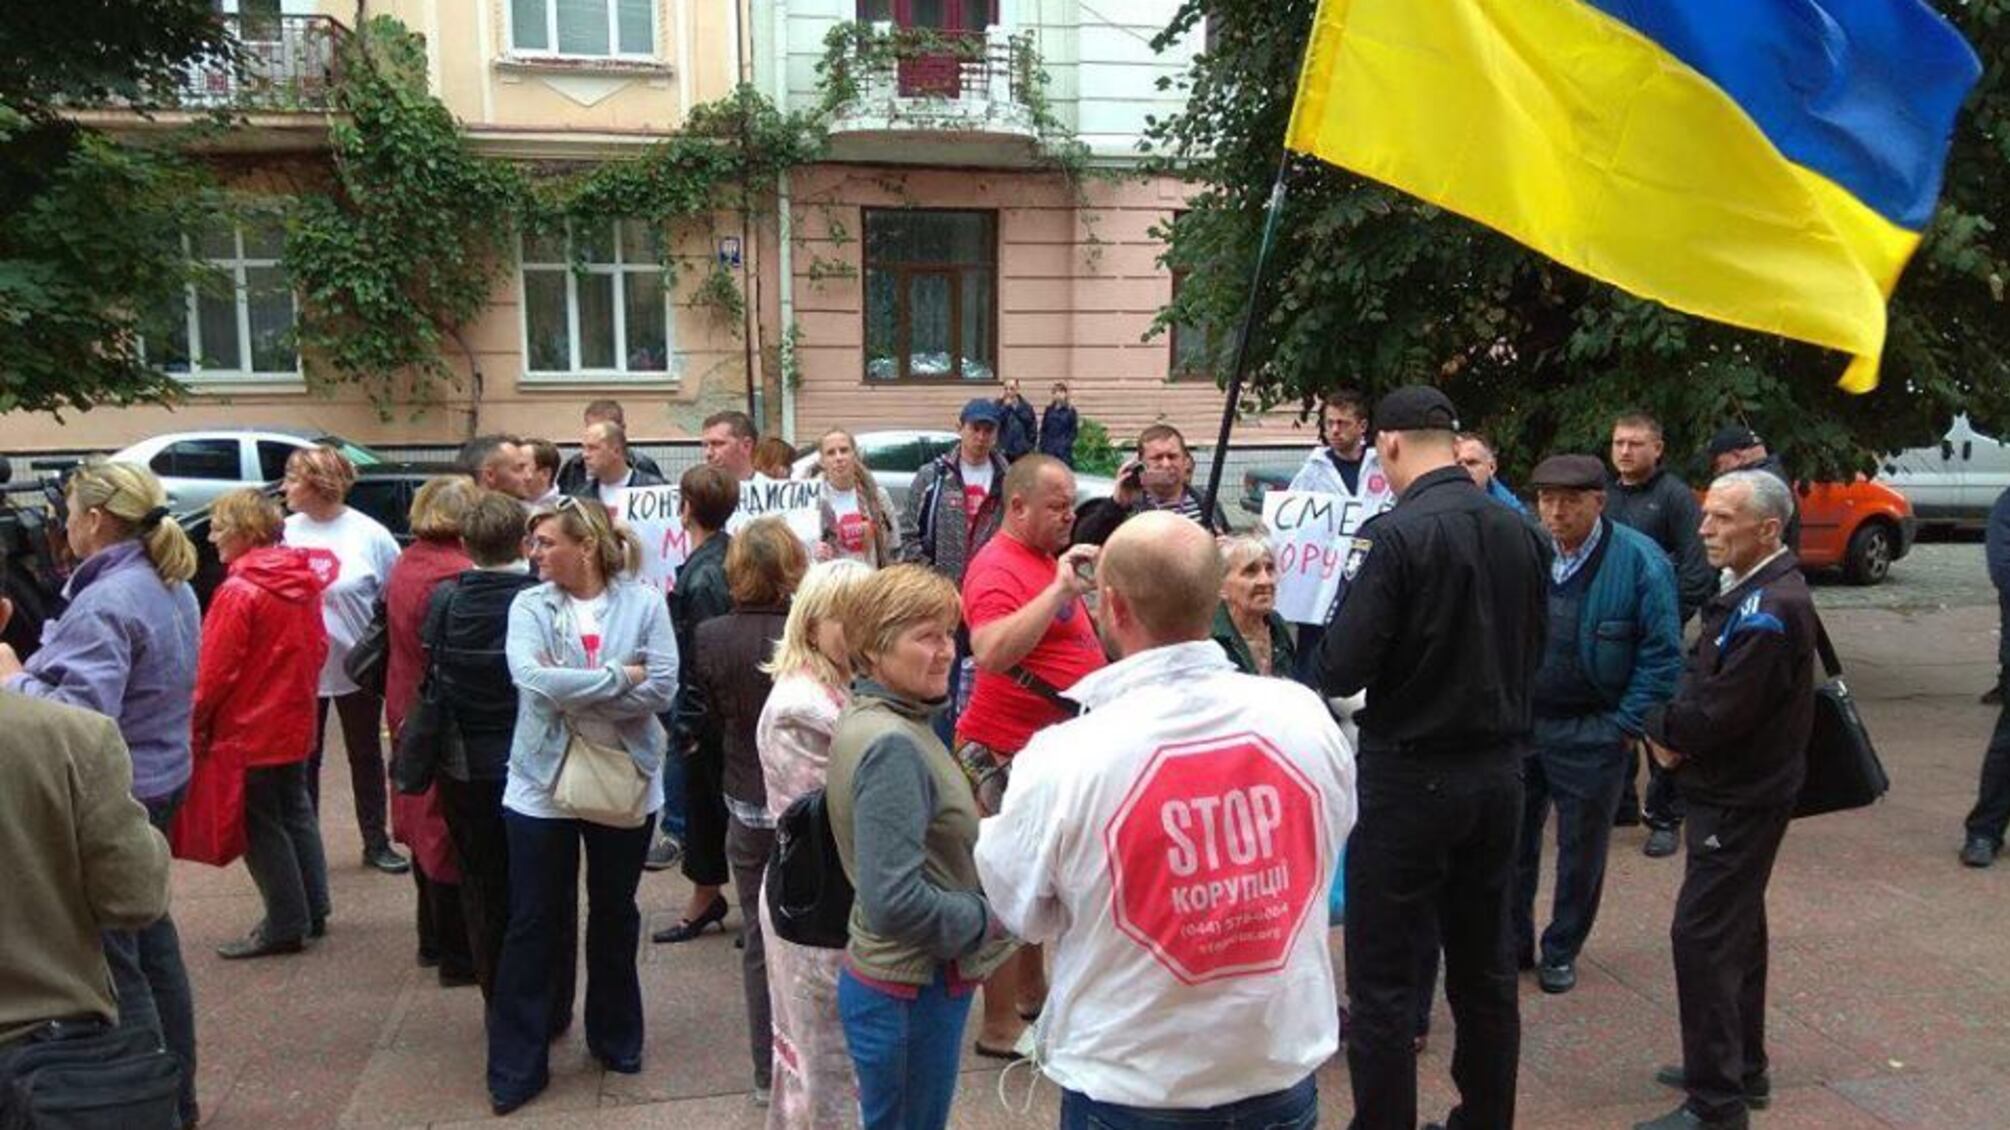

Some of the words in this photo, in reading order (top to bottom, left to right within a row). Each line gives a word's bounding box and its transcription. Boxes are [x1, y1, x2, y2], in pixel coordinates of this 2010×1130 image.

[1274, 496, 1391, 537] СМЕ
[1279, 542, 1339, 580] ОРУ
[1160, 783, 1283, 877] STOP
[1170, 862, 1290, 914] КОРУПЦІЇ
